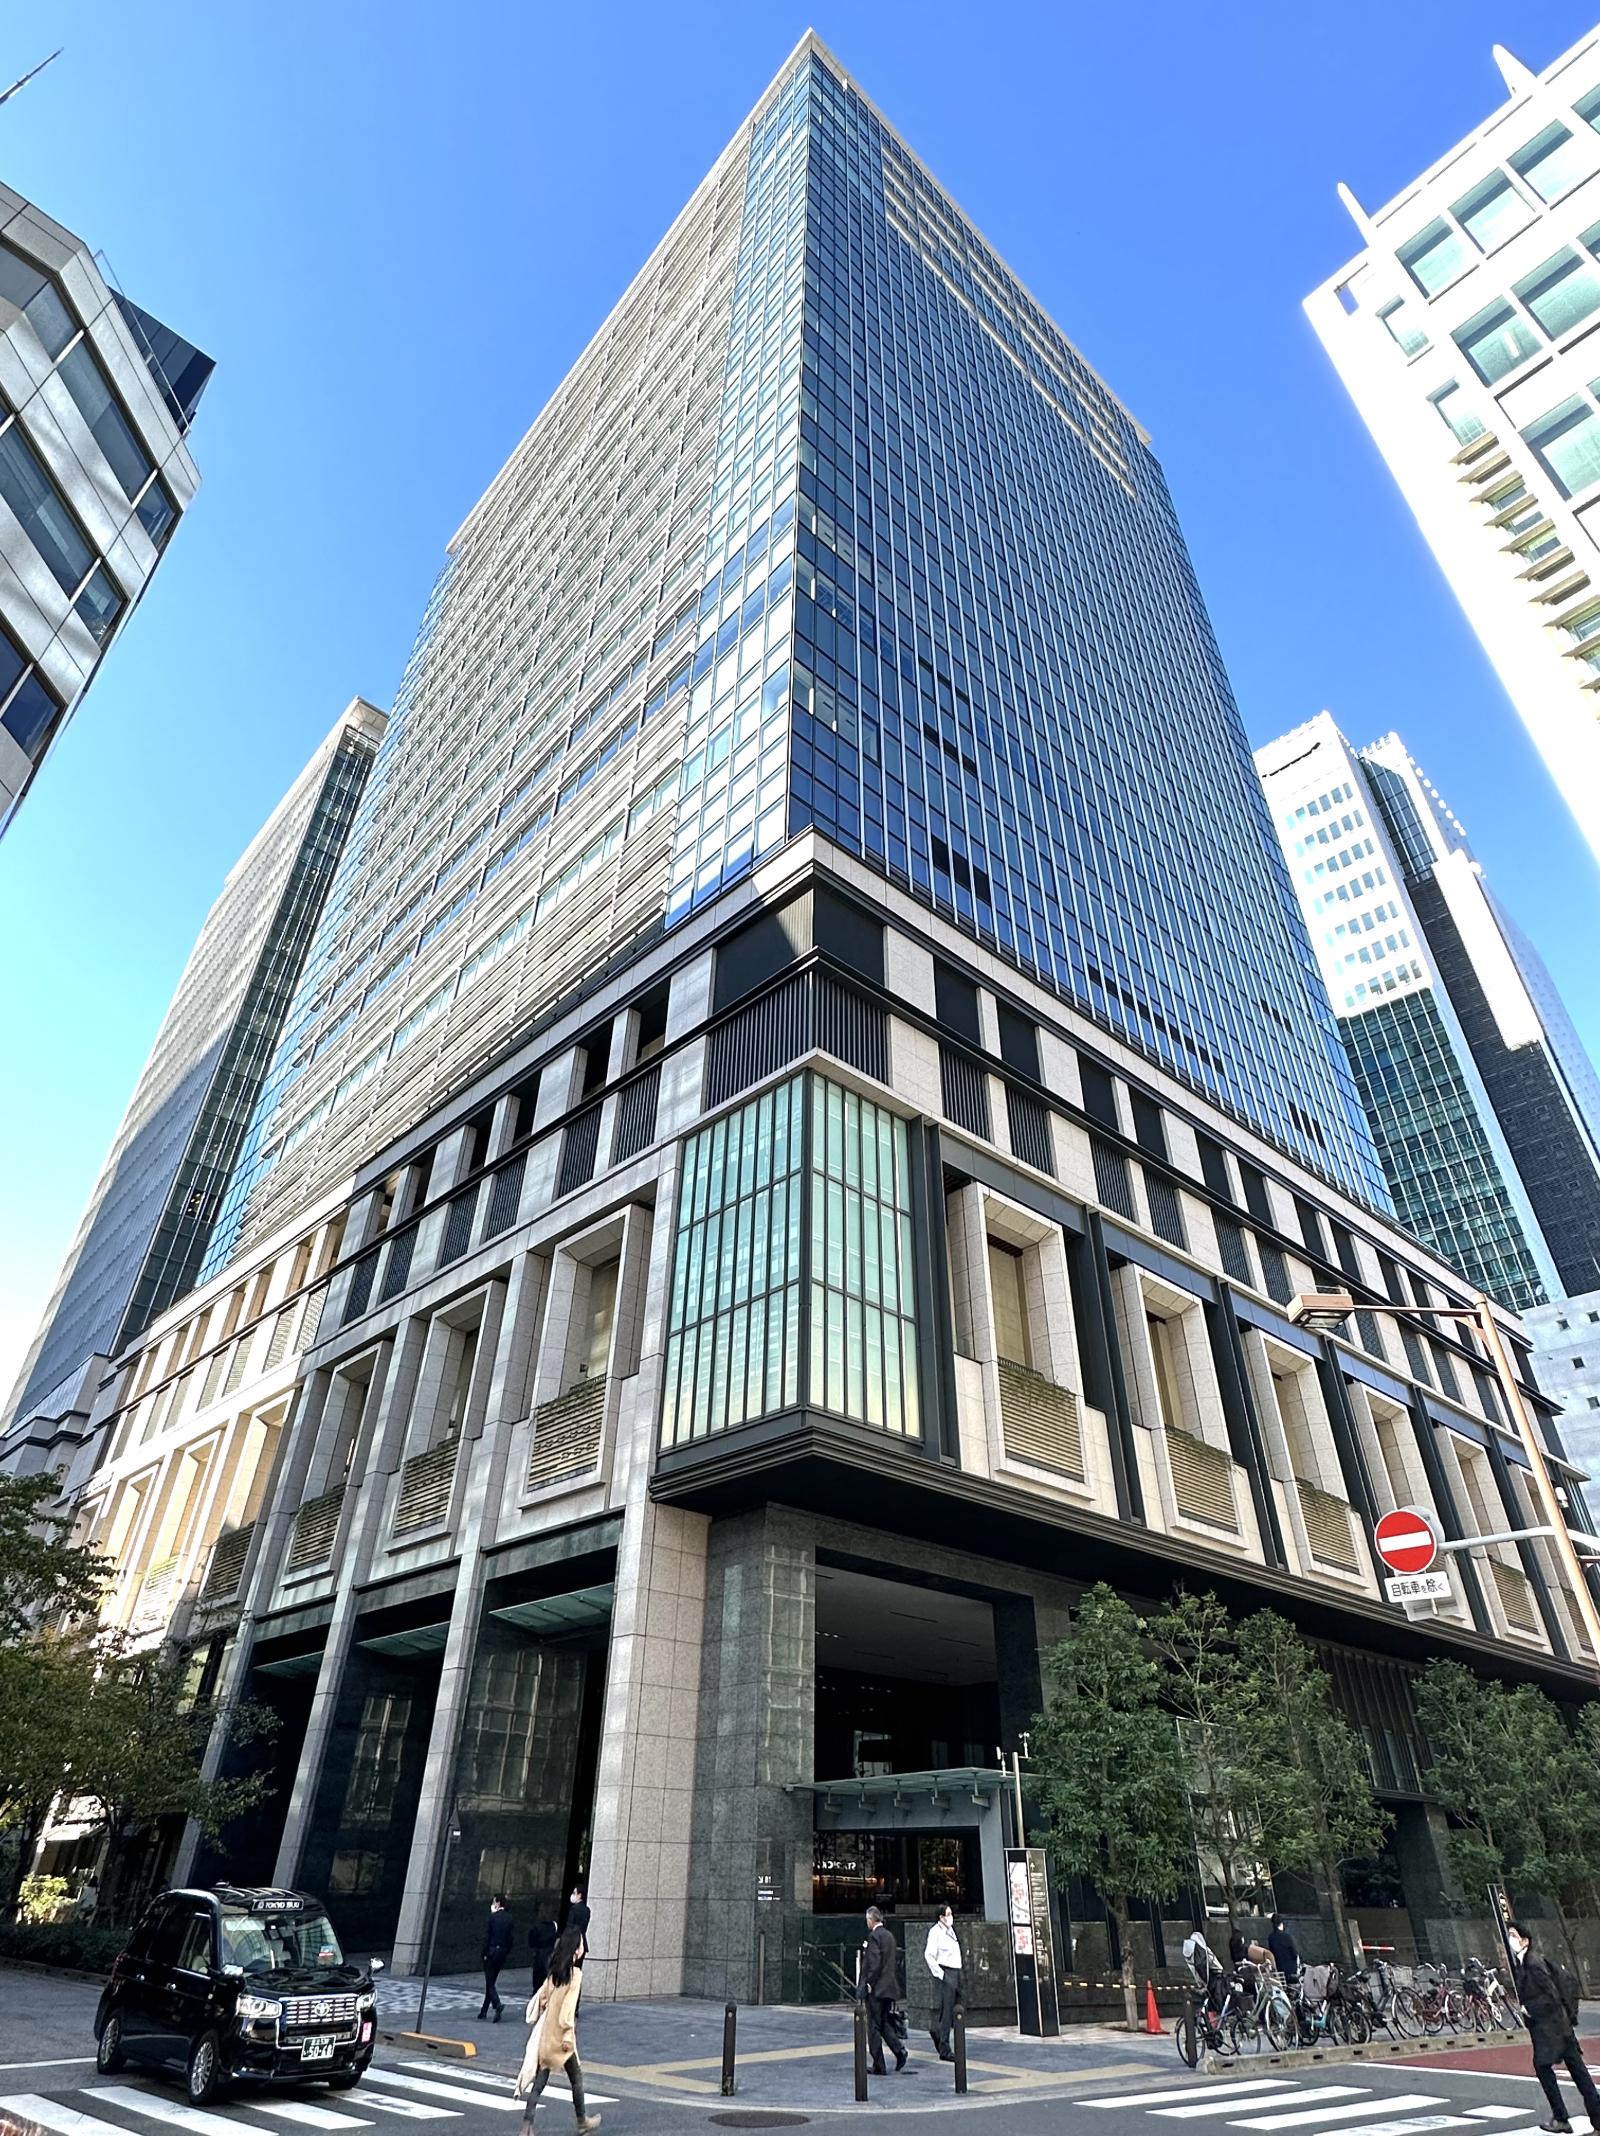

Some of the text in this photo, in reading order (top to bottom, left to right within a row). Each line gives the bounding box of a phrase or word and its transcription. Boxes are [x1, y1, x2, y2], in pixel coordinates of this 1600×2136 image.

[1391, 1579, 1446, 1597] 自転車を除く
